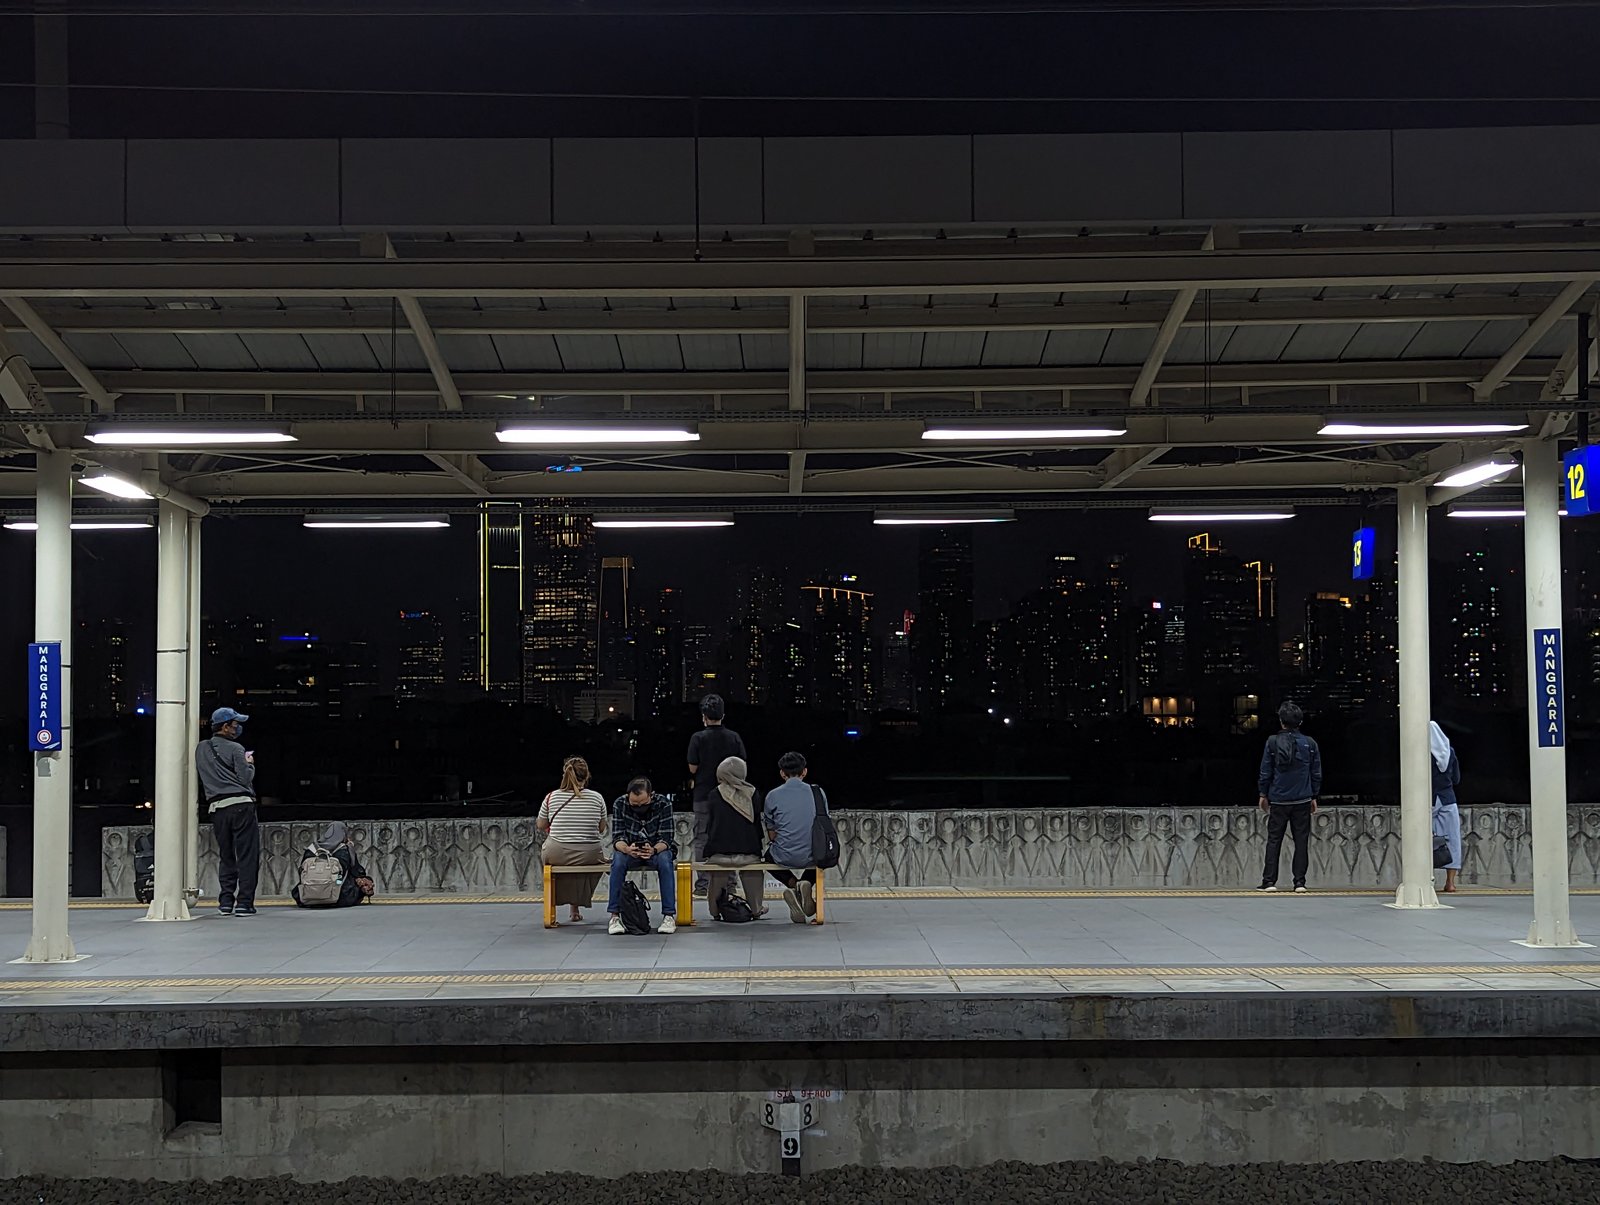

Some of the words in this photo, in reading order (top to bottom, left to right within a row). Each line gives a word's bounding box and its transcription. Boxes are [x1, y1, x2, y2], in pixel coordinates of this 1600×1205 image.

[1567, 463, 1585, 500] 12
[38, 646, 48, 728] MANGGARAI
[1543, 634, 1558, 745] MANGGARAI
[765, 1103, 774, 1125] 8
[803, 1103, 812, 1125] 8
[783, 1137, 799, 1156] 9
